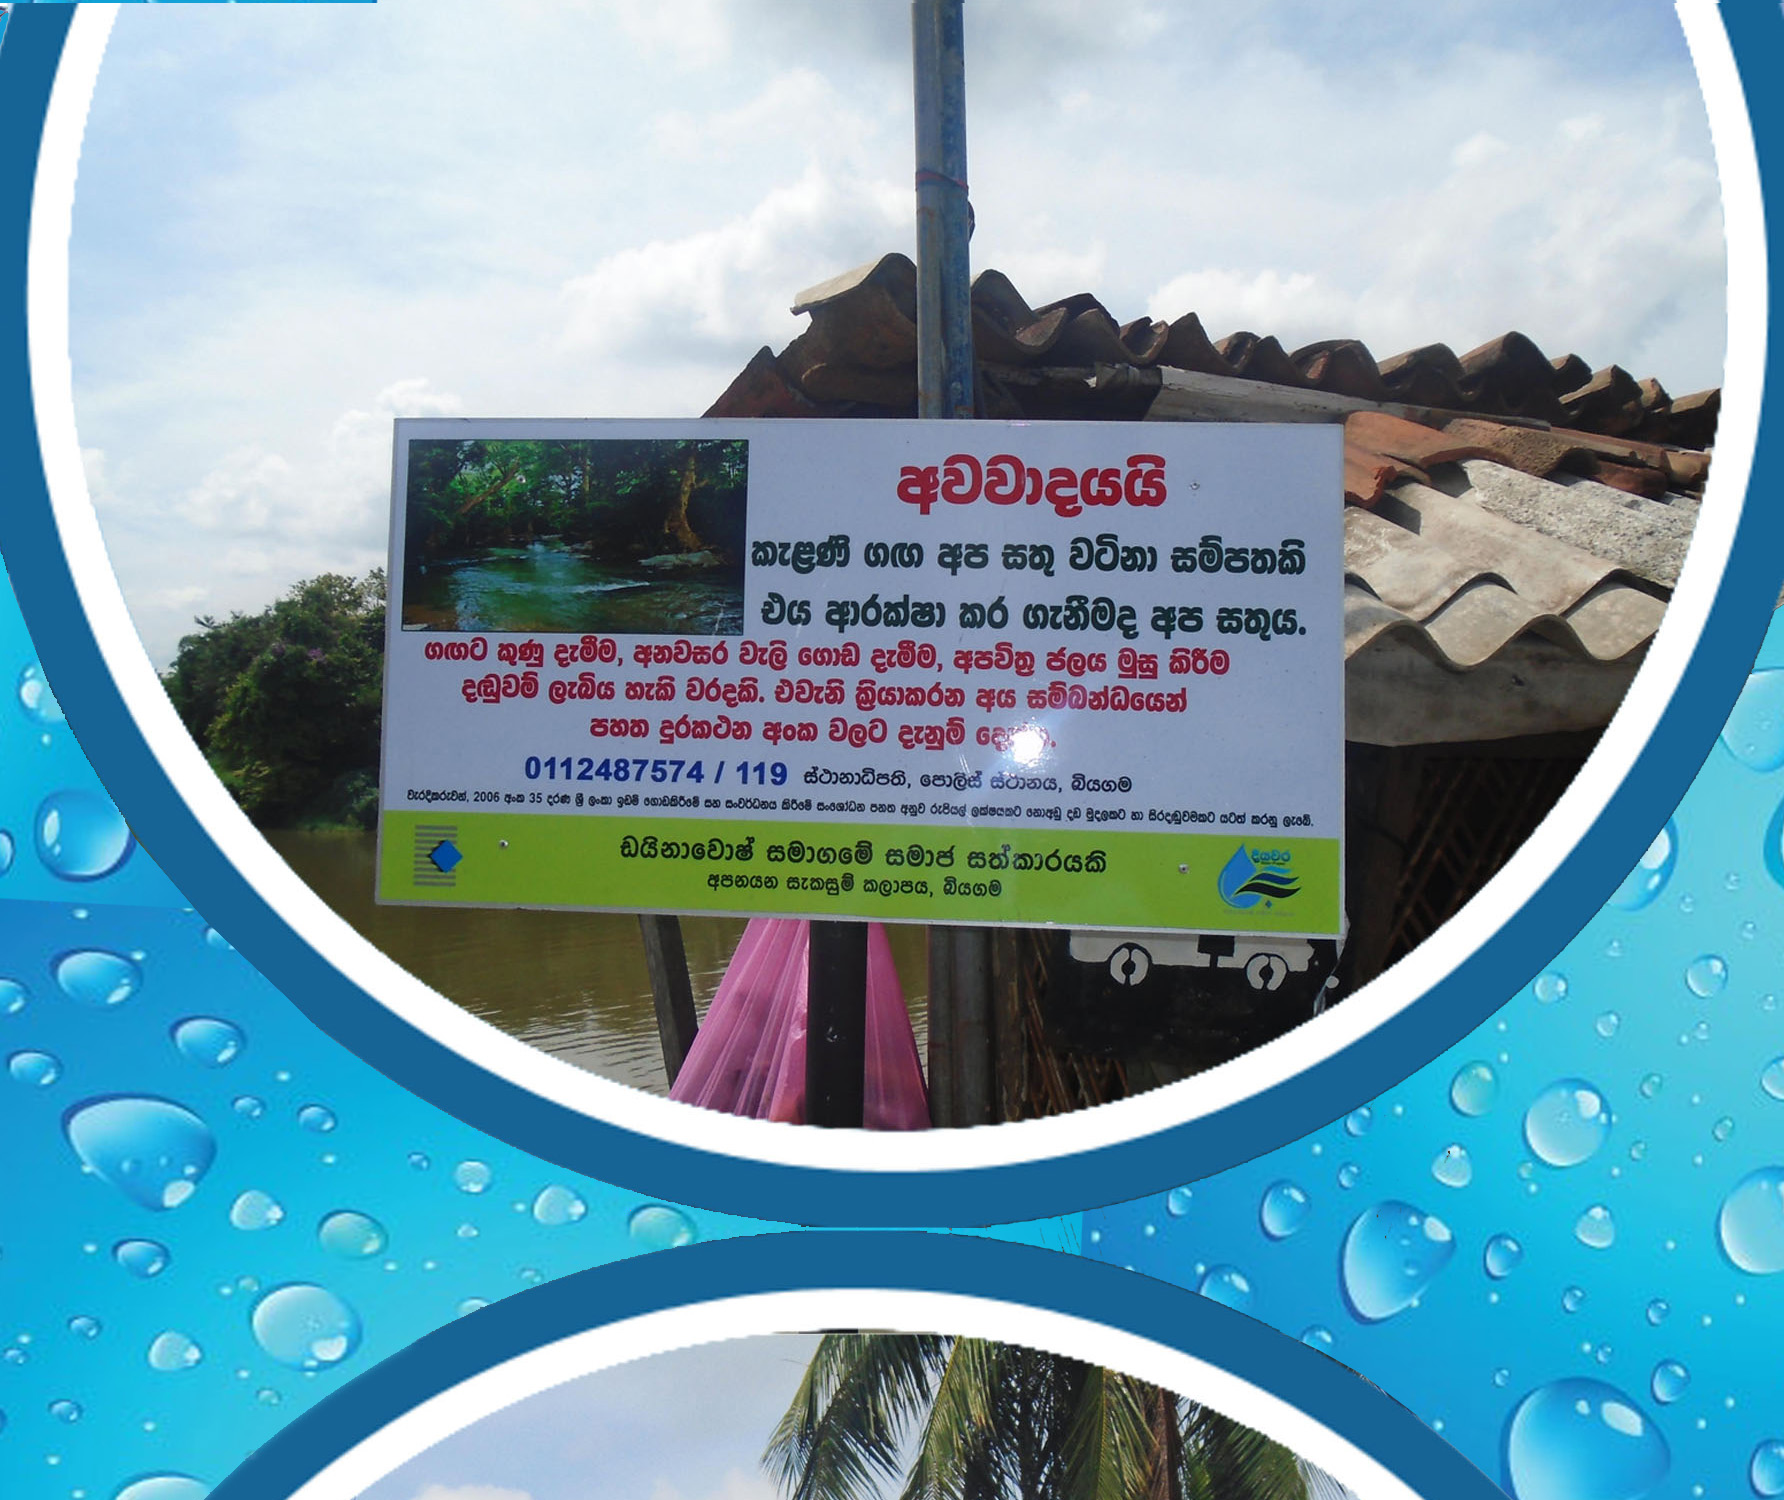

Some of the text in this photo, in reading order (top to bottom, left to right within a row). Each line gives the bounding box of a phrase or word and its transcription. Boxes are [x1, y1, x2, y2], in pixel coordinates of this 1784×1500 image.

[897, 454, 1166, 517] අවවාදයයි
[752, 534, 1305, 576] කැළණි ගඟ අප සතු වටිනා සම්පතකි
[620, 836, 1106, 873] ඩයිනාවොෂ් සමාගමේ සමාජ සත්කාරයකි
